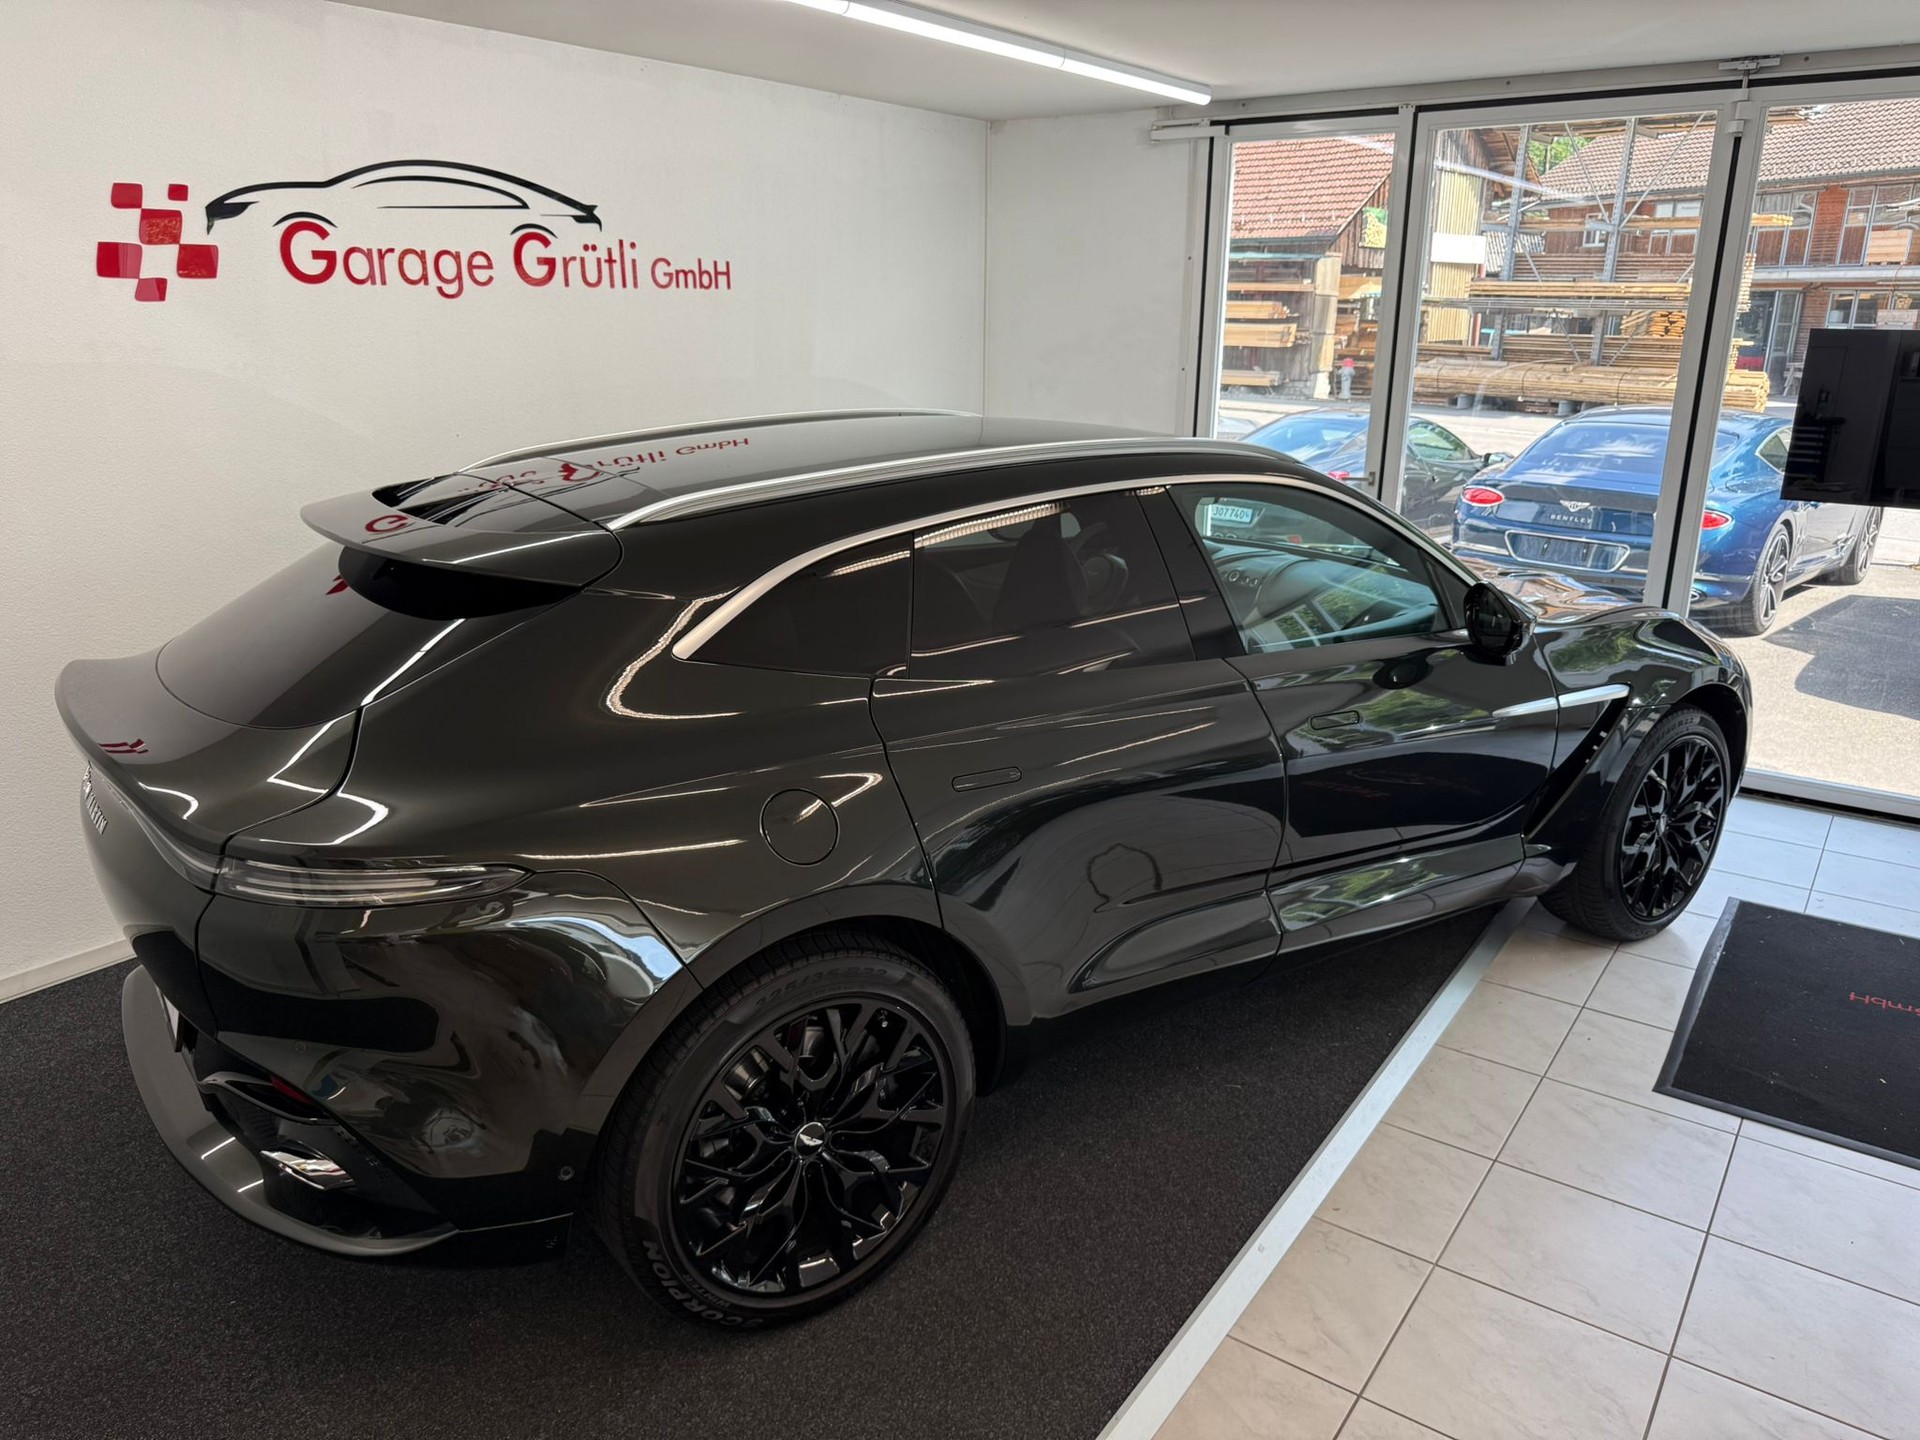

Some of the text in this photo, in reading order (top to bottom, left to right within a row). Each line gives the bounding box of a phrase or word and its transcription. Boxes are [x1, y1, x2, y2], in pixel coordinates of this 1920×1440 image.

[279, 219, 732, 300] Garage Grütli GmbH
[1550, 513, 1592, 524] BENTLEY
[641, 1239, 765, 1329] SCORPION
